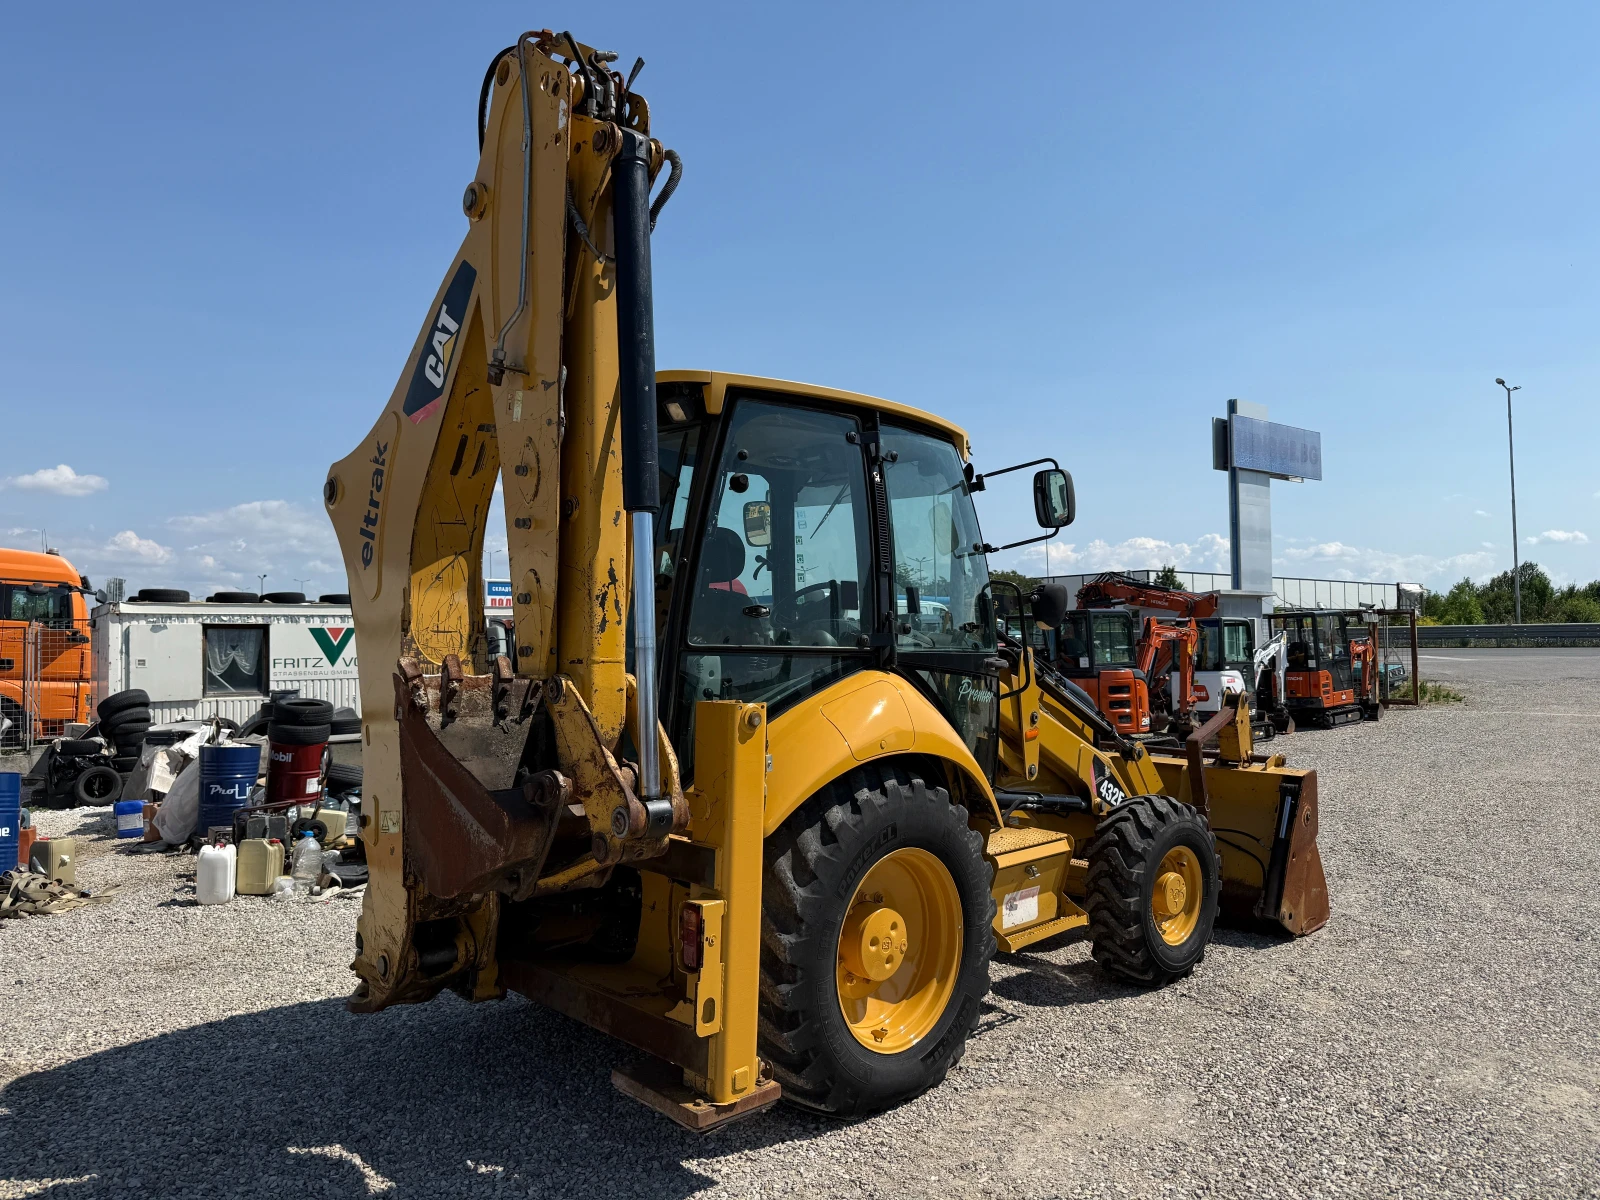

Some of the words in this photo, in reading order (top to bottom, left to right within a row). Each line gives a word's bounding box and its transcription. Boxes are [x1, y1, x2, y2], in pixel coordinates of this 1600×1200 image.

[424, 303, 460, 389] CAT
[359, 440, 389, 571] eltrak
[272, 657, 324, 669] FRITZ
